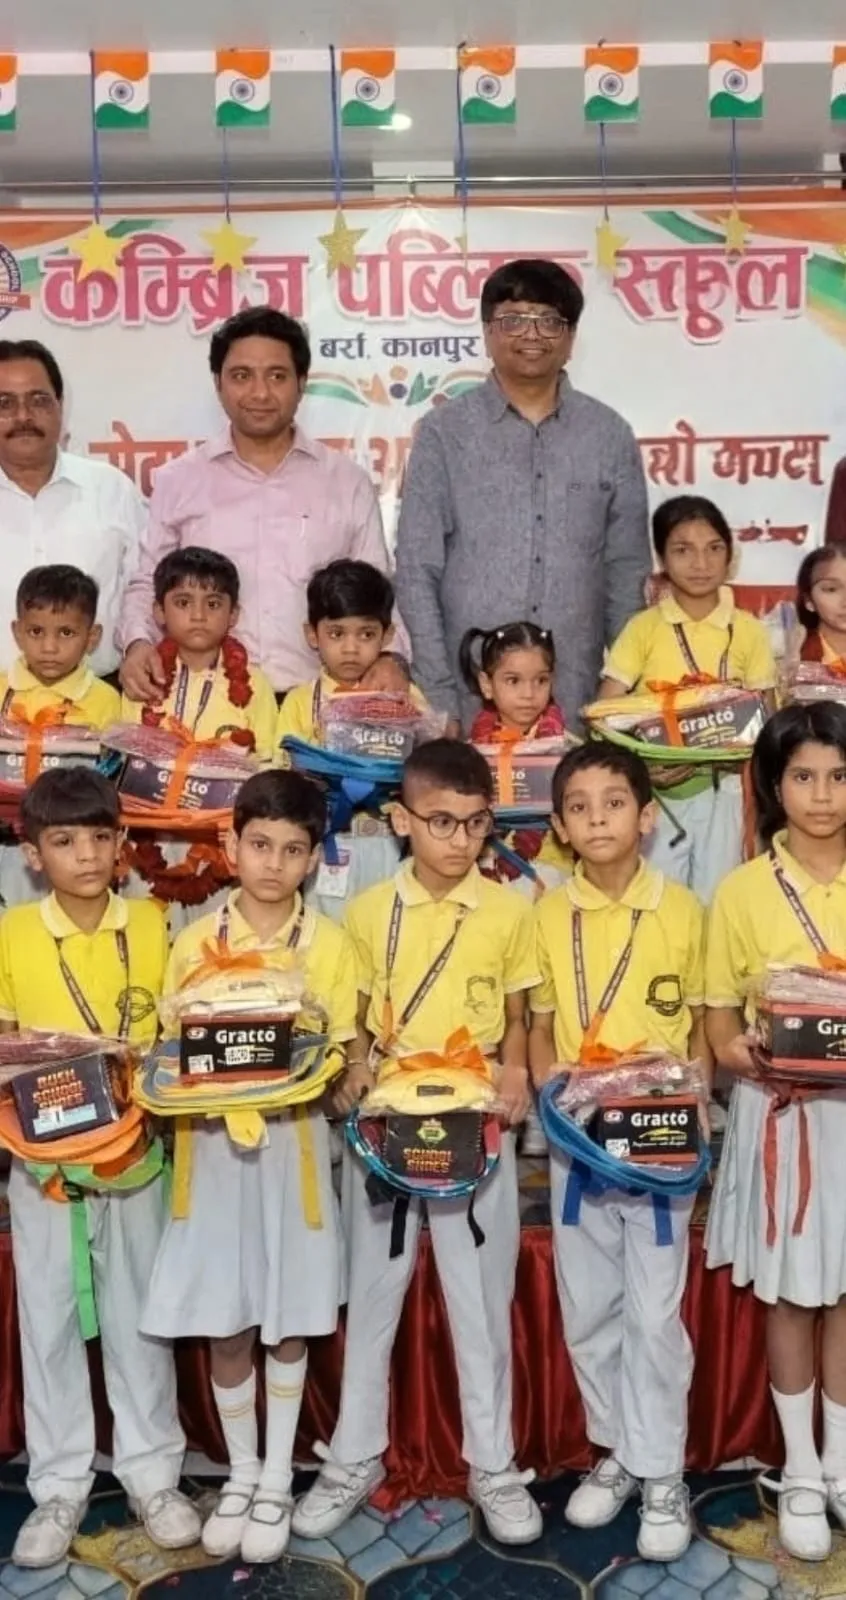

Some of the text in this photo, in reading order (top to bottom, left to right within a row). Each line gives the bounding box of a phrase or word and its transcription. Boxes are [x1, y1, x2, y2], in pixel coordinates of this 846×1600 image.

[336, 229, 588, 320] पब्लि
[613, 247, 809, 339] स्कूल
[381, 336, 480, 362] कानपुर
[678, 709, 734, 734] Gratto
[6, 754, 60, 767] Grto
[215, 1029, 277, 1044] Gratto
[33, 1080, 86, 1104] SCHOOL
[631, 1112, 689, 1127] Gratto
[403, 1148, 453, 1162] SCHOOL
[407, 1160, 450, 1173] SHOES
